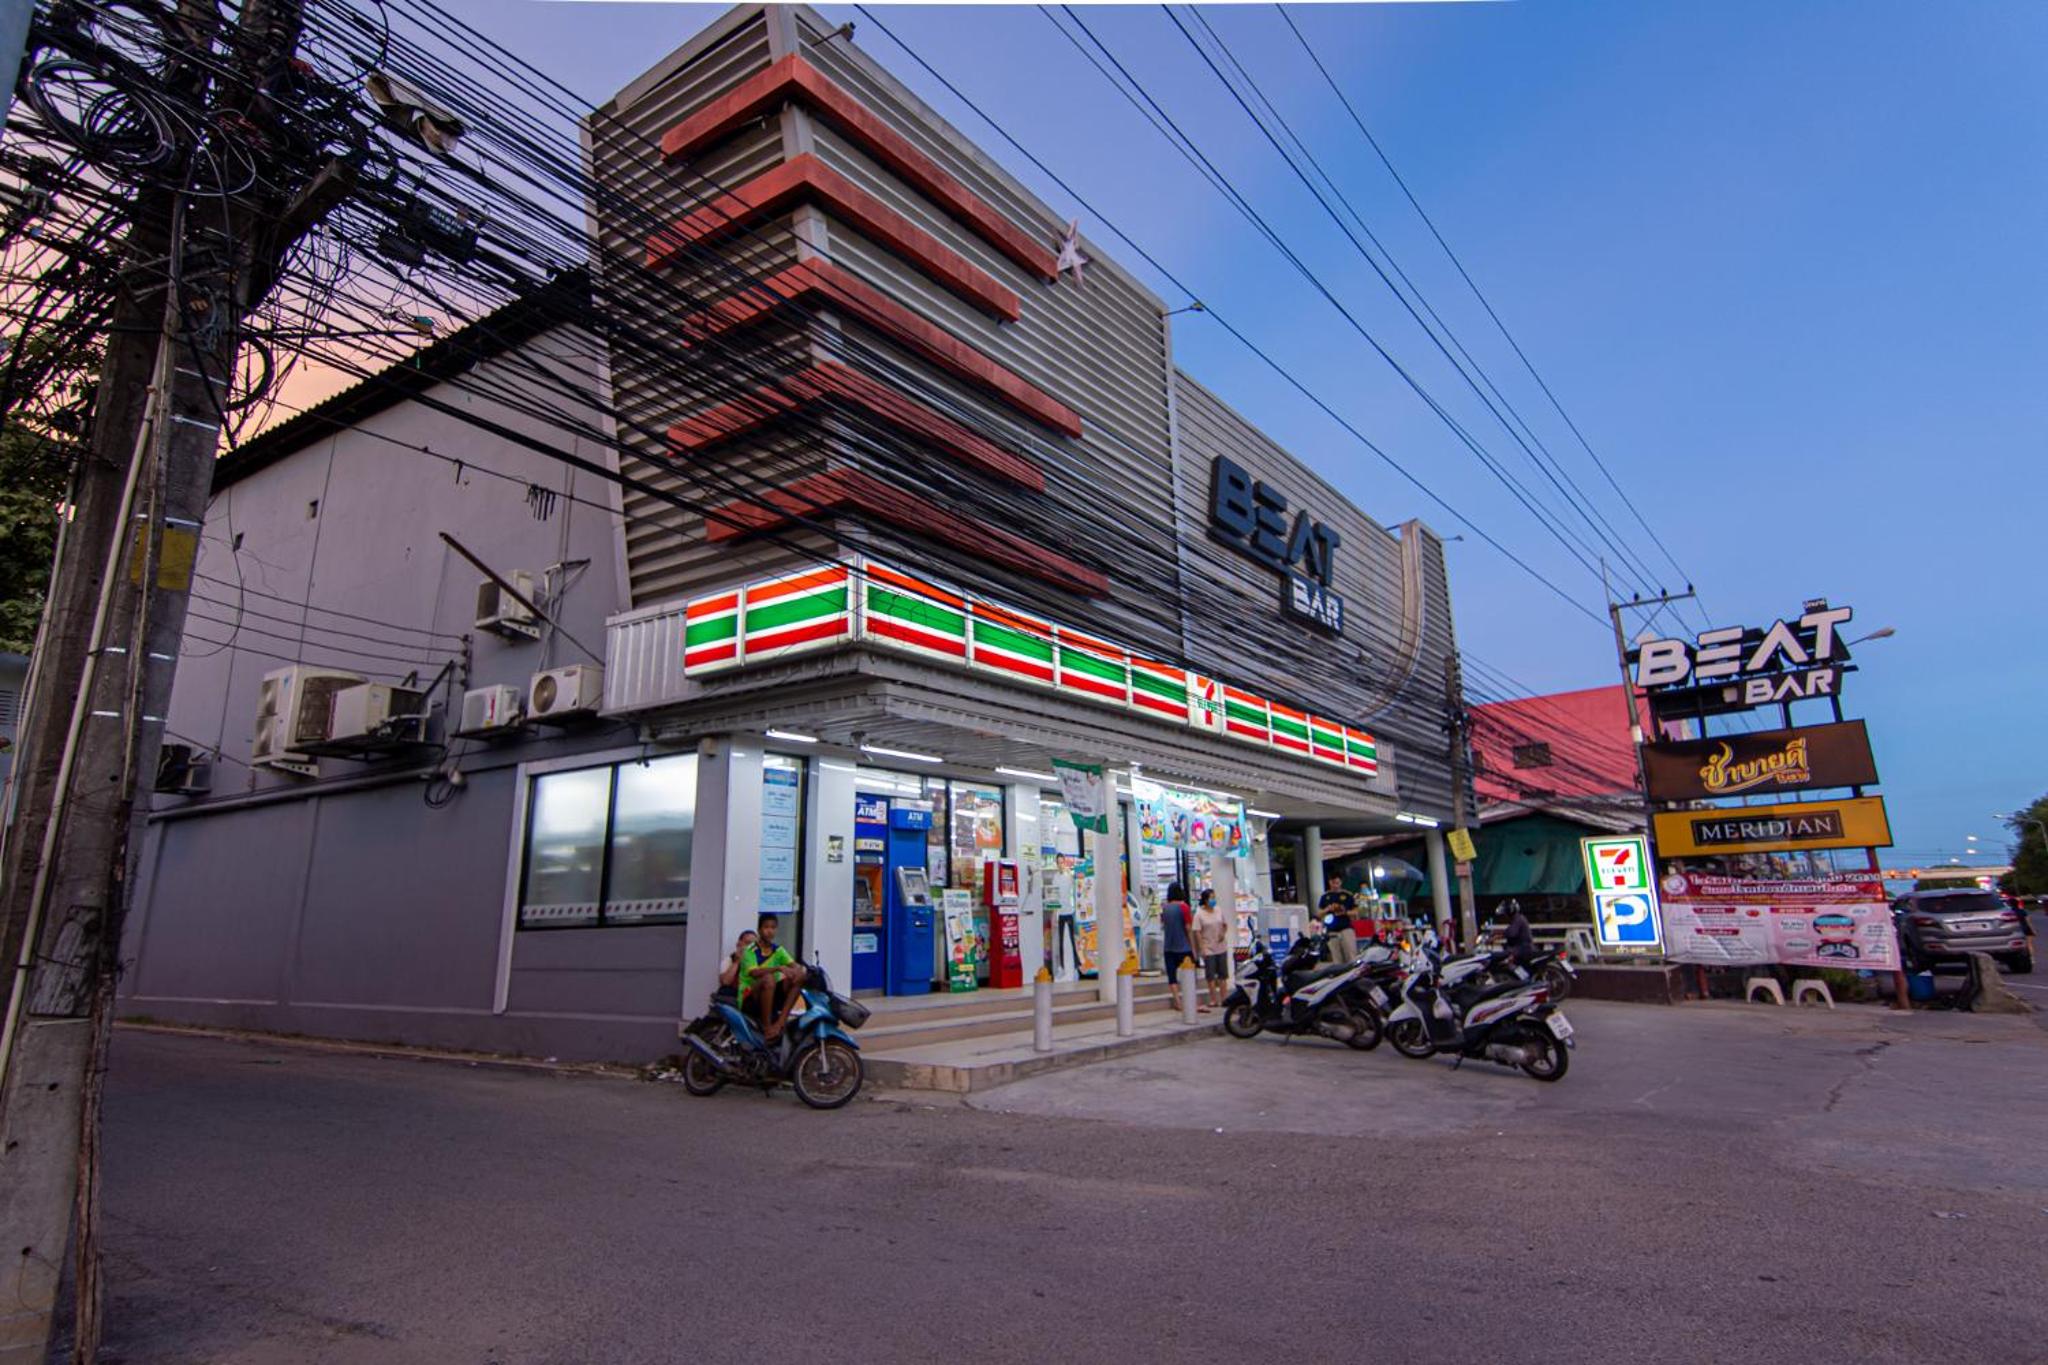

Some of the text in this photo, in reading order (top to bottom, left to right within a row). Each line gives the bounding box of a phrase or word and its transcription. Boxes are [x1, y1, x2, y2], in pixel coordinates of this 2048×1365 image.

[1209, 454, 1341, 587] BEAT
[1291, 578, 1341, 631] BAR
[1637, 606, 1852, 688] BEAT
[1745, 668, 1834, 705] BAR
[908, 812, 924, 821] ATM
[1701, 817, 1832, 840] MERIDIAN
[1600, 894, 1648, 941] P
